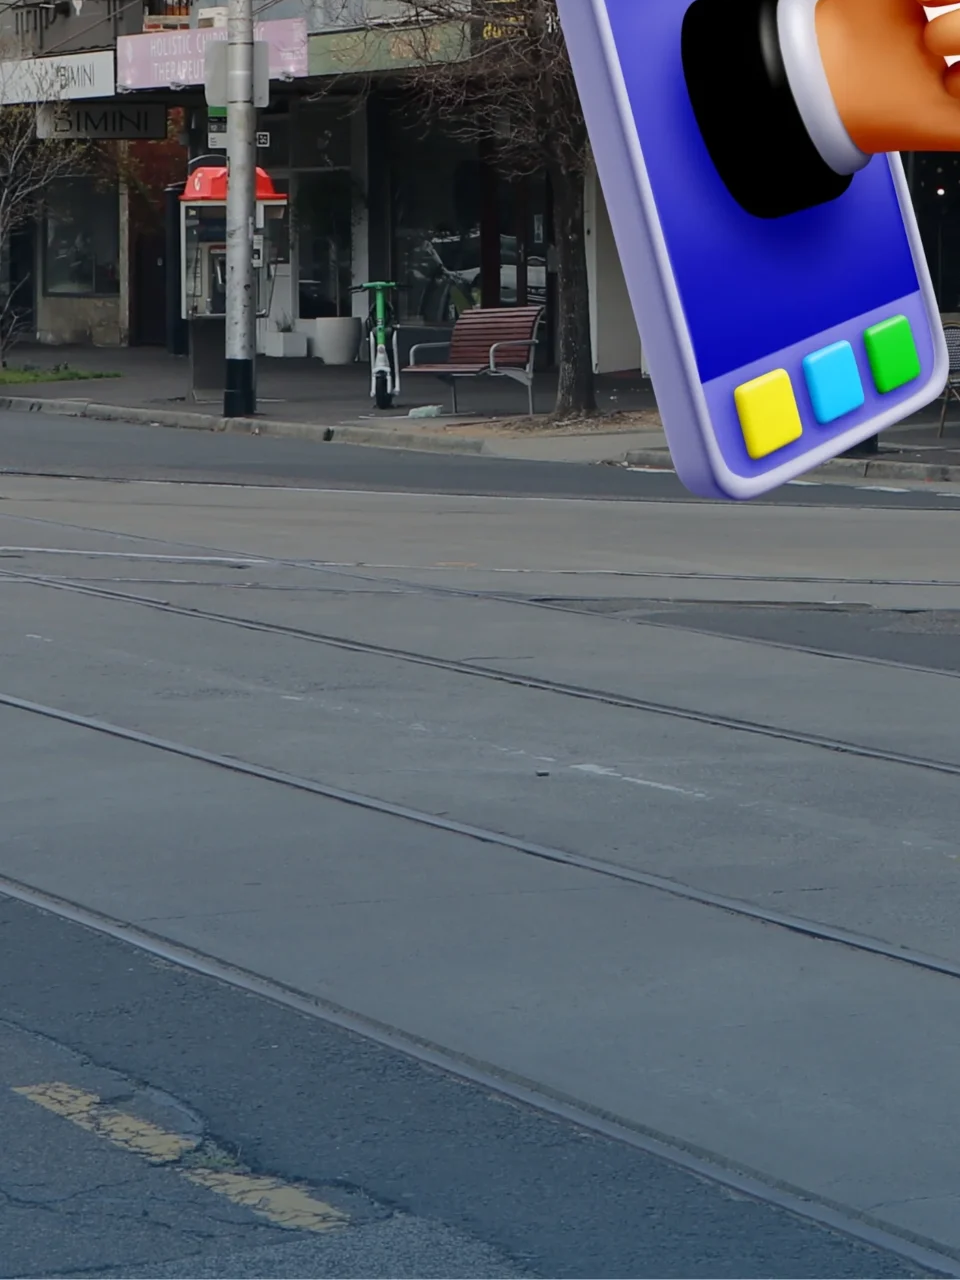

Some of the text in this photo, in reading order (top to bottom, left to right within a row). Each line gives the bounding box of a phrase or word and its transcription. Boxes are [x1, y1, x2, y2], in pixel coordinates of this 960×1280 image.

[150, 34, 192, 57] HOLISTIC
[153, 59, 205, 81] THERAPEUT
[54, 110, 148, 132] BIMINI
